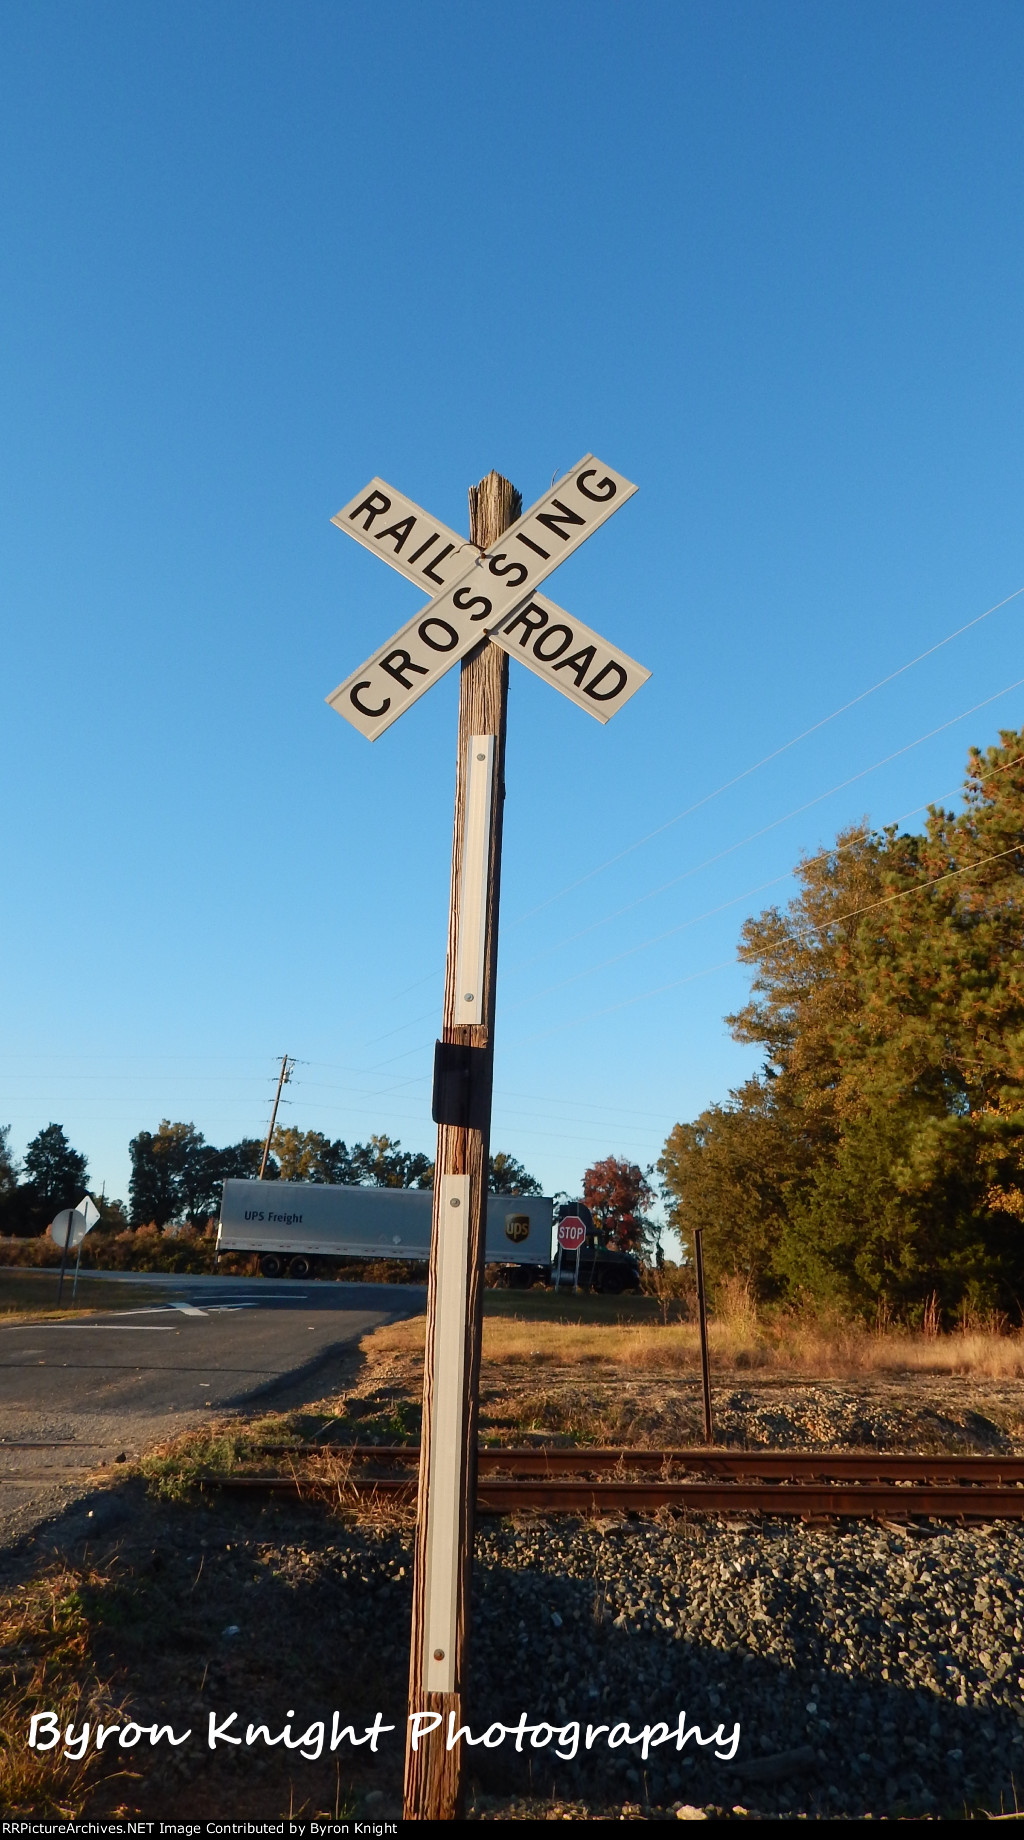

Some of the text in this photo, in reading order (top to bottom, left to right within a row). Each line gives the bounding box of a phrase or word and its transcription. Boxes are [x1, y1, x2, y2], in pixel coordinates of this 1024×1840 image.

[348, 489, 456, 585] RAIL
[349, 469, 617, 718] CROSSING
[502, 602, 628, 701] ROAD
[244, 1210, 303, 1226] UPS Freight
[559, 1226, 584, 1240] STOP
